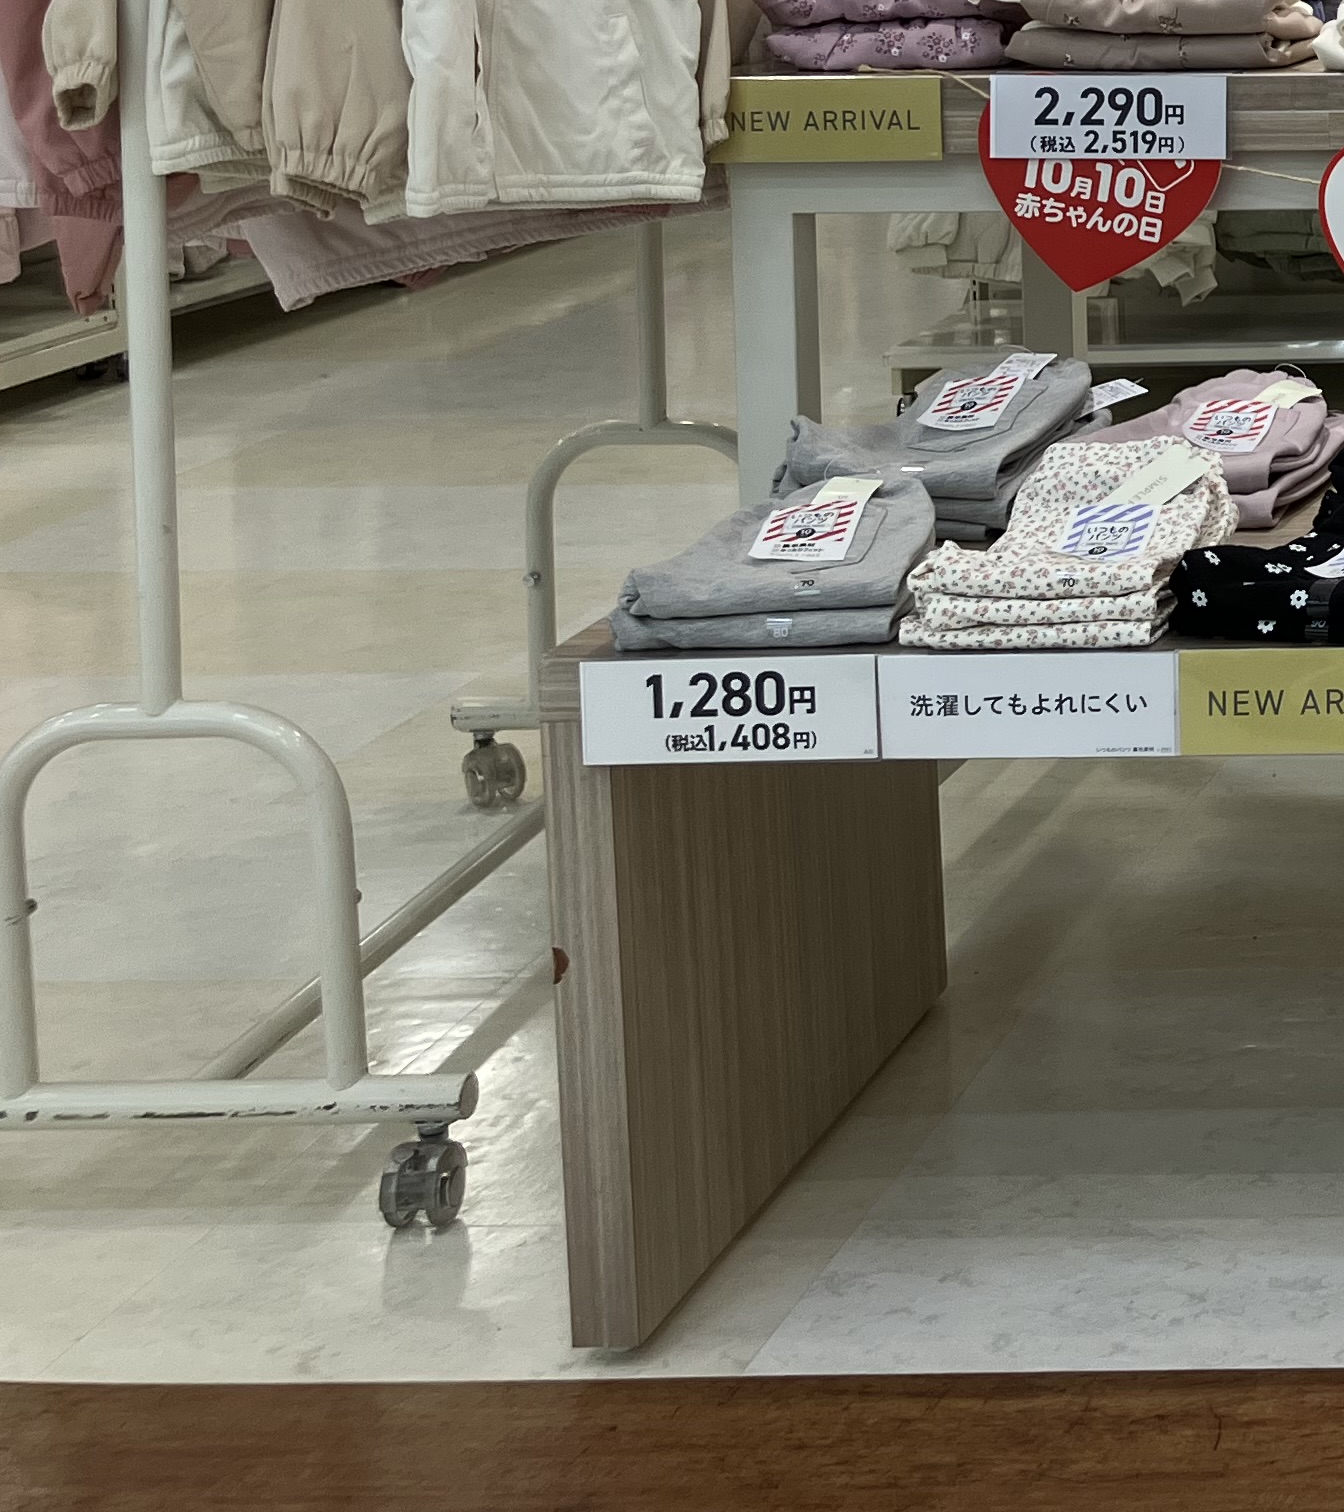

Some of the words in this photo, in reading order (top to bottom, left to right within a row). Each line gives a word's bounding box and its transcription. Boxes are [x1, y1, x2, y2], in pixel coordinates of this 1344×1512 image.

[1034, 86, 1185, 127] 2,290円
[730, 111, 791, 133] NEW
[803, 108, 921, 132] ARRIVAL
[1030, 135, 1076, 153] (税込
[1083, 130, 1186, 154] 2,519円)
[1024, 159, 1165, 214] 10月10日
[1014, 192, 1163, 244] 赤ちゃんの日
[790, 511, 835, 521] いつもの
[1087, 526, 1129, 534] いつもの
[800, 579, 814, 587] 70
[1062, 578, 1075, 587] 70
[773, 627, 788, 639] 80
[645, 670, 817, 719] 1,280円
[909, 692, 1149, 717] 洗濯してもよれにくい
[1207, 689, 1285, 717] NEW
